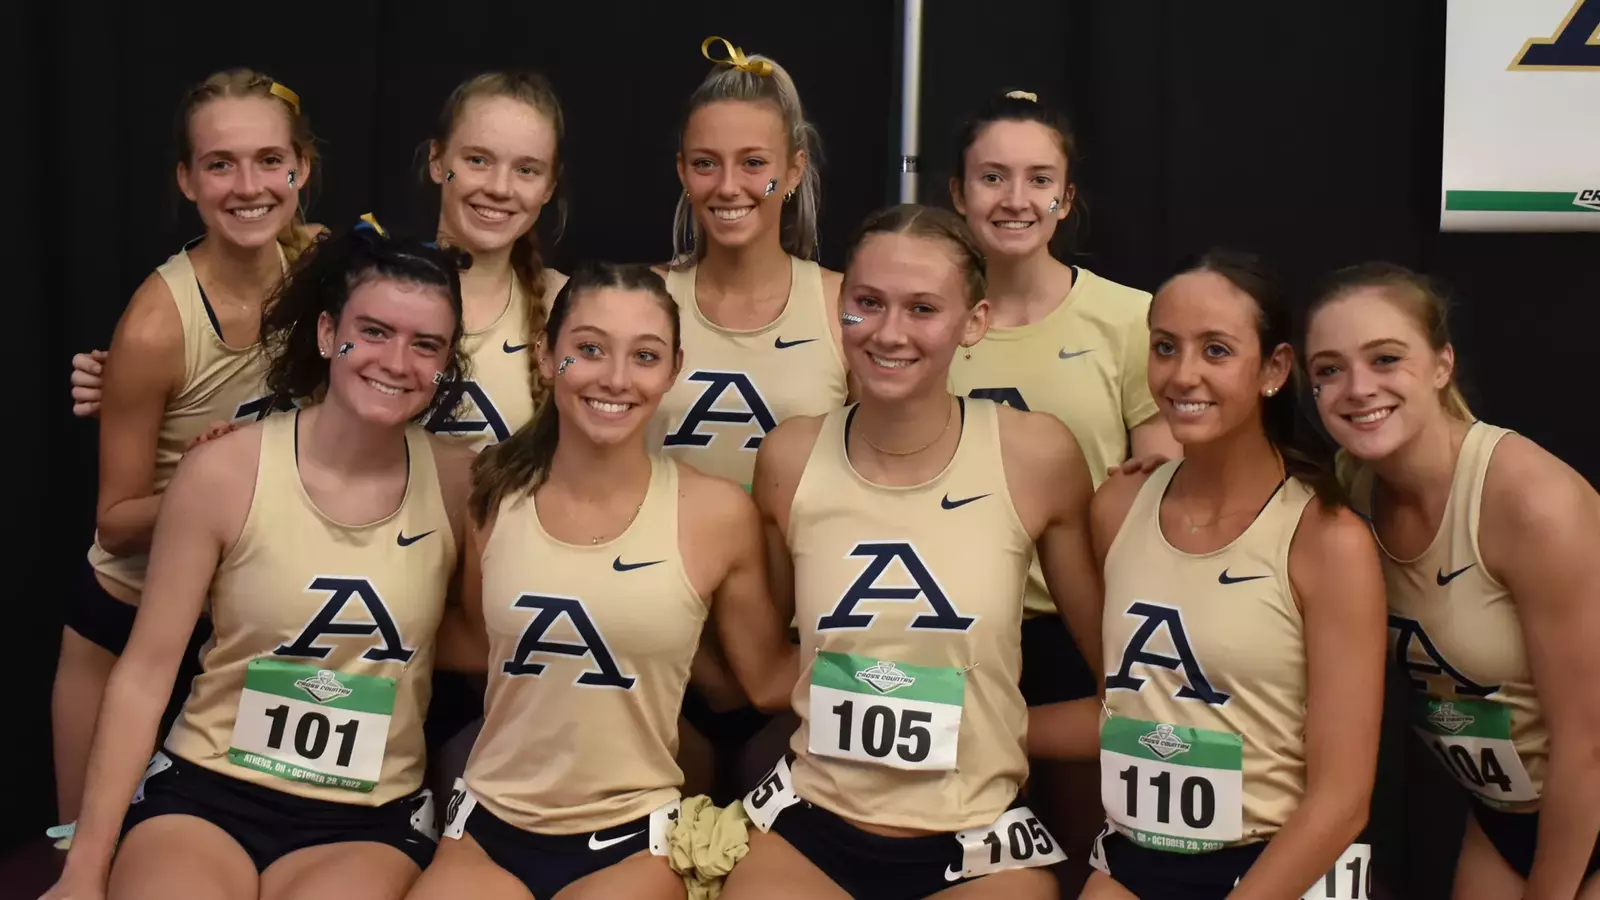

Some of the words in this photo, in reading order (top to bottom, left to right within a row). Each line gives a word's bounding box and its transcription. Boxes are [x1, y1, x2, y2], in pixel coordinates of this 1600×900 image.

[661, 369, 777, 451] A
[272, 574, 416, 663] A
[816, 540, 981, 632] A
[501, 592, 640, 690] A
[1105, 600, 1231, 706] A
[1387, 614, 1504, 698] A
[264, 704, 360, 767] 101
[832, 700, 932, 762] 105
[243, 754, 273, 770] ATHENS,
[275, 763, 287, 774] OH
[292, 769, 325, 784] OCTOBER
[341, 779, 361, 789] 2022
[1120, 765, 1215, 829] 110
[982, 818, 1054, 864] 105
[1152, 835, 1185, 849] OCTOBER
